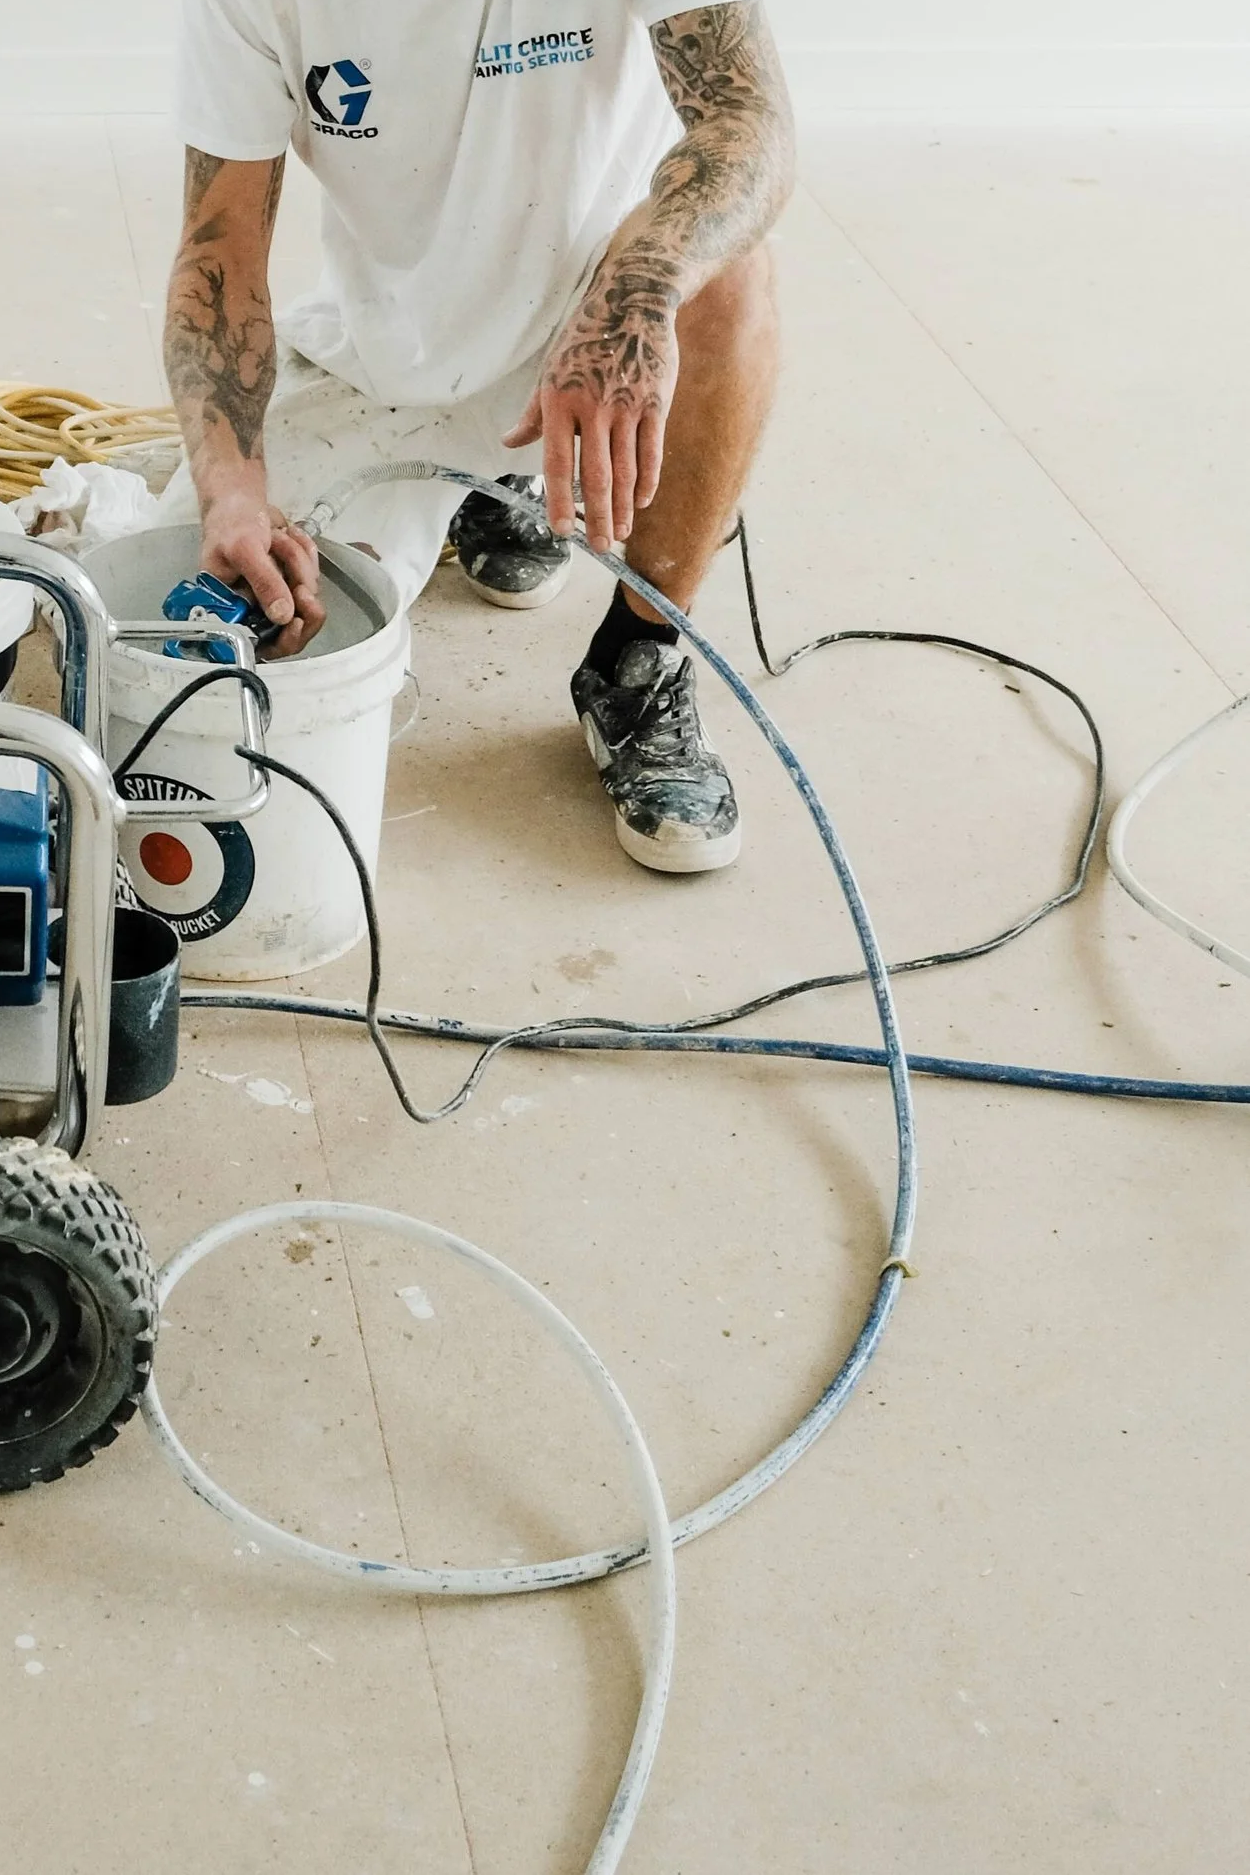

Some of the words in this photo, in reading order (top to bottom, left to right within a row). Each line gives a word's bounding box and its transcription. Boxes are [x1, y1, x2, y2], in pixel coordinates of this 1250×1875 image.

[518, 27, 594, 57] CHOICE
[528, 46, 595, 70] SERVICE
[123, 777, 207, 801] SPITFI
[170, 908, 222, 936] BUCKET
